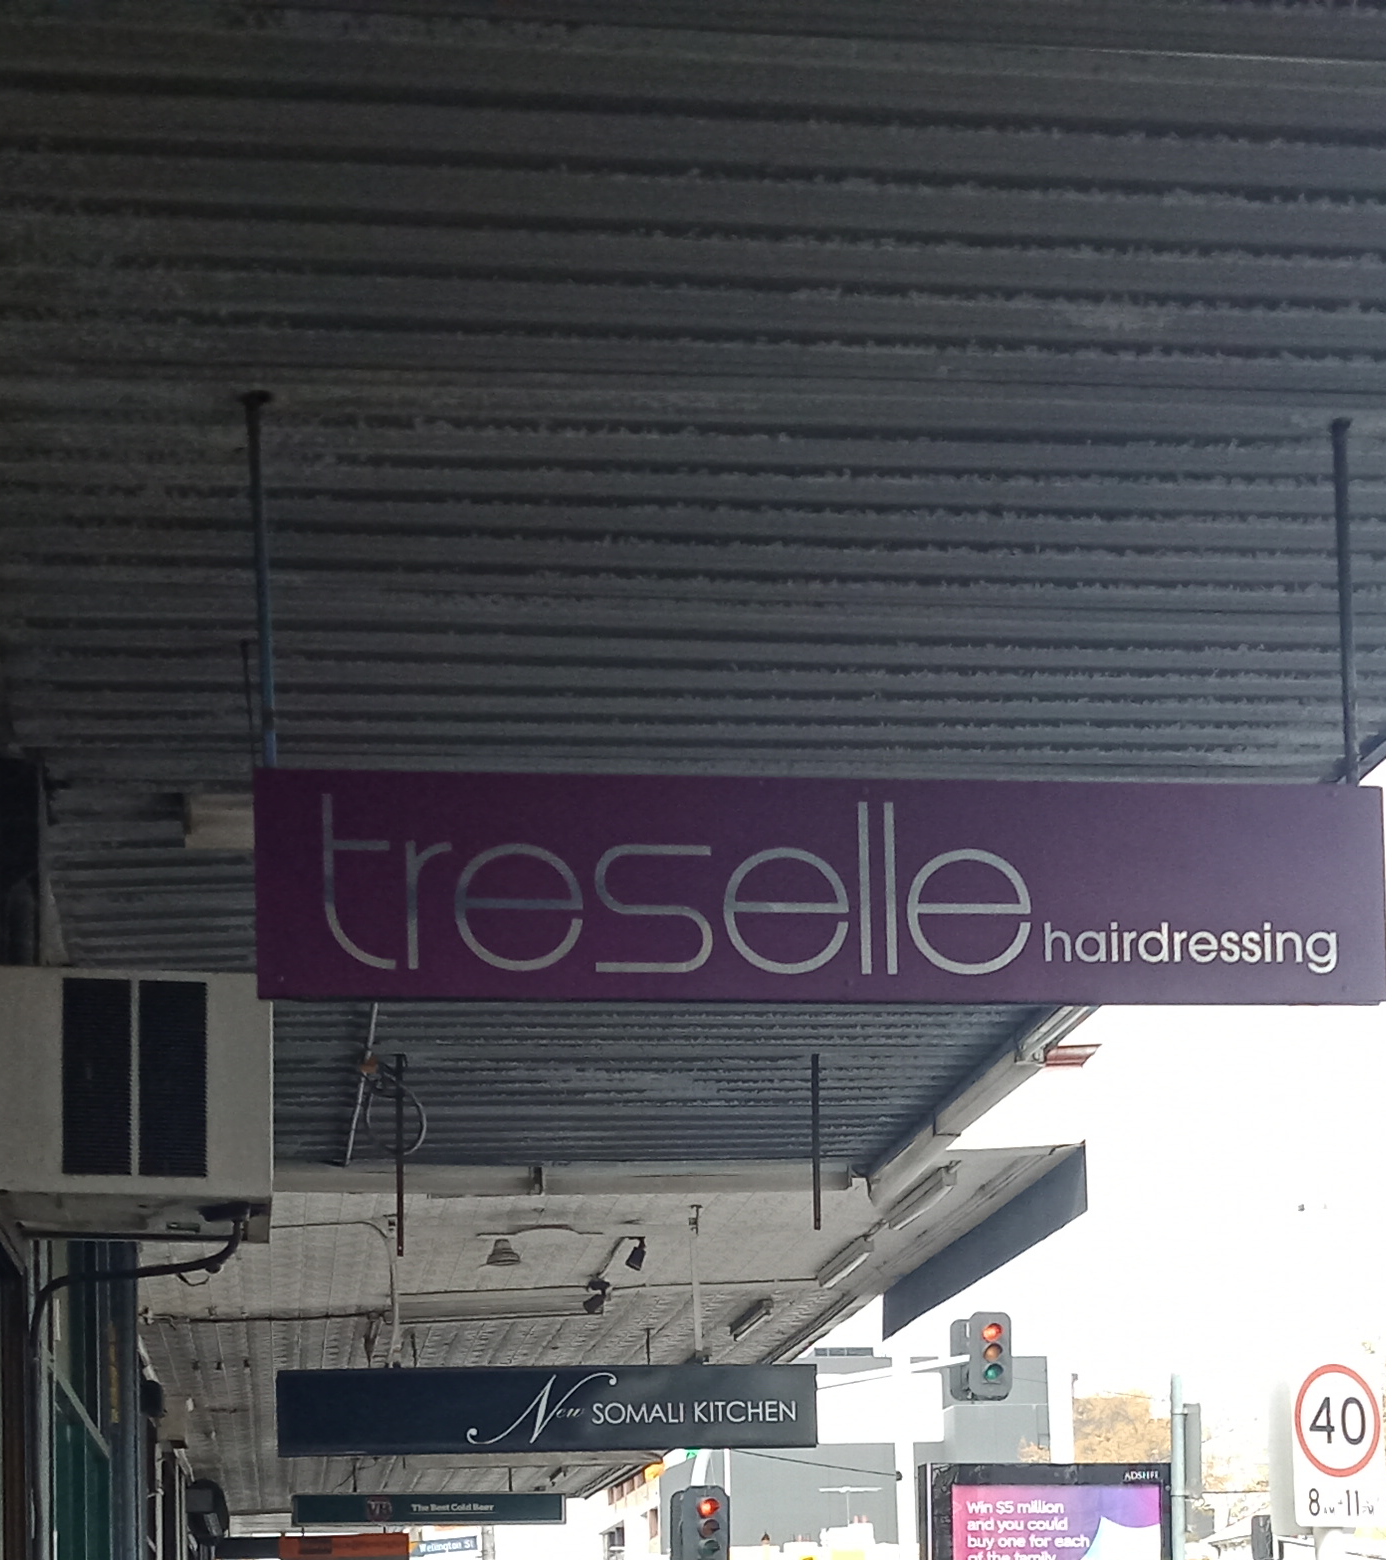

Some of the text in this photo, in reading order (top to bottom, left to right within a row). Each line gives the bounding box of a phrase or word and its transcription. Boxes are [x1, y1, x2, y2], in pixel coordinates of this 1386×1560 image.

[322, 793, 1339, 976] treselle hairdressing
[466, 1372, 797, 1445] New SOMALI KITCHEN
[1309, 1396, 1366, 1445] 40
[411, 1503, 494, 1512] The Best Cold Beer
[967, 1500, 1064, 1516] Win $5 million
[967, 1517, 1068, 1533] and you could
[419, 1540, 474, 1553] Wellington St
[967, 1534, 1090, 1550] buy one for each
